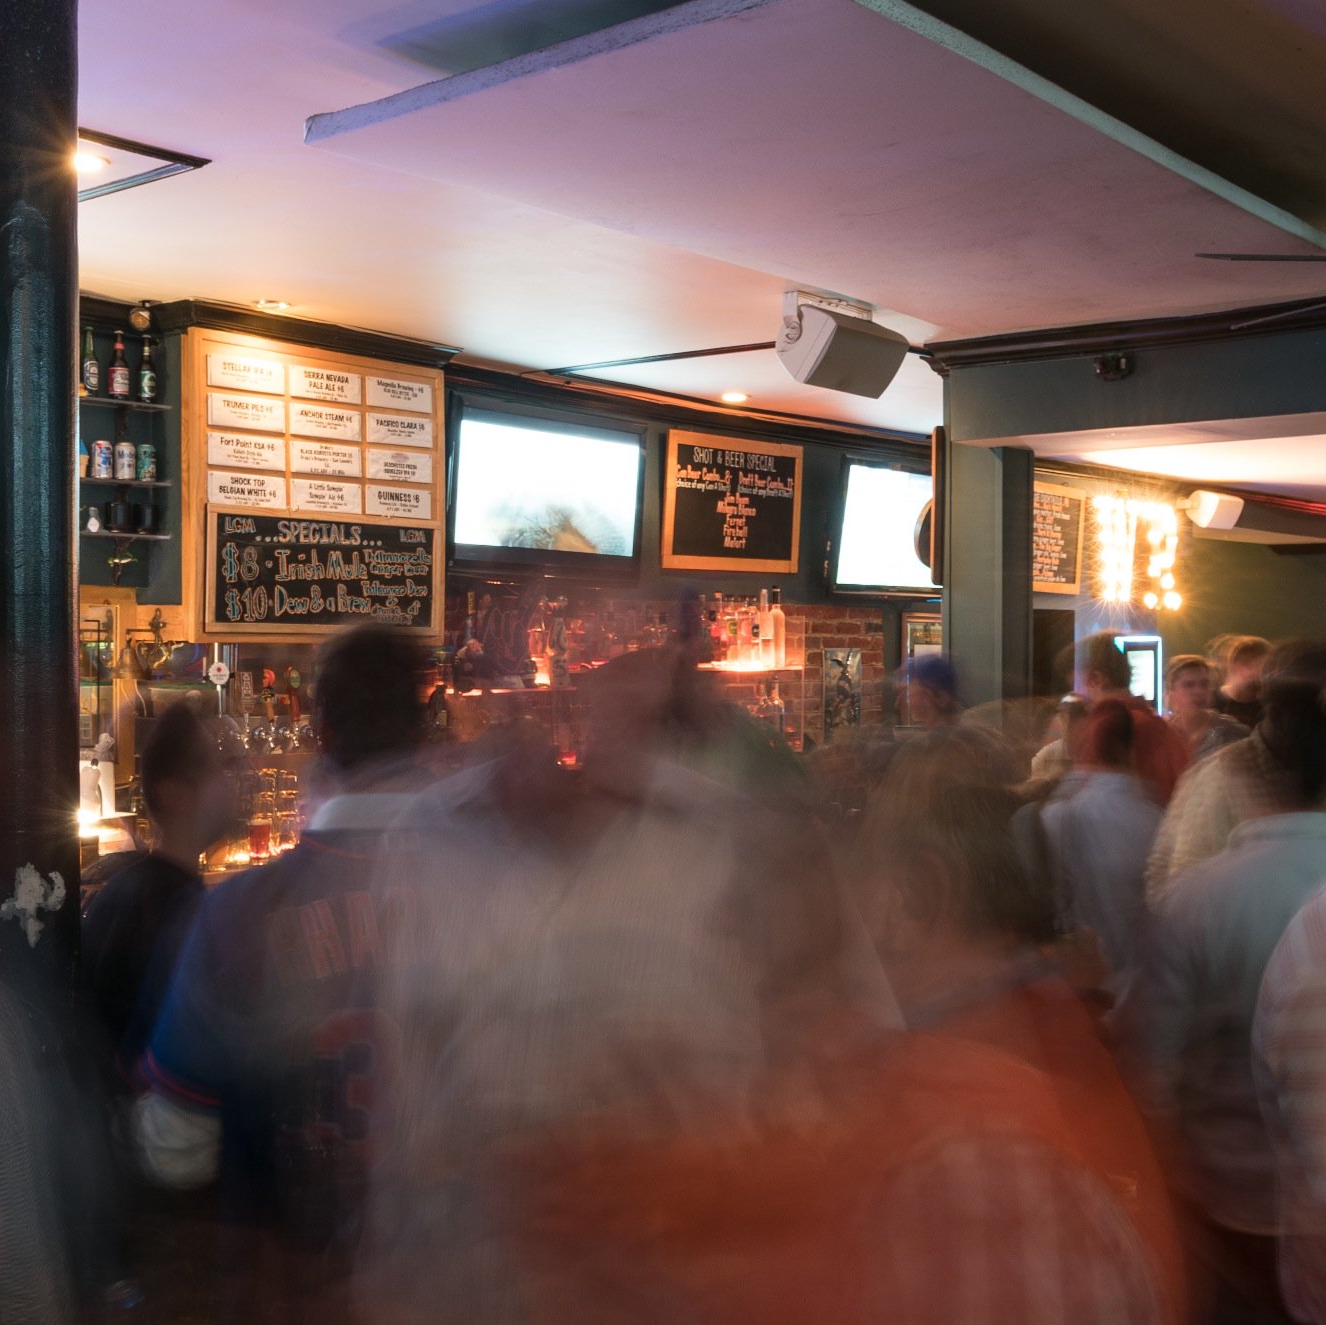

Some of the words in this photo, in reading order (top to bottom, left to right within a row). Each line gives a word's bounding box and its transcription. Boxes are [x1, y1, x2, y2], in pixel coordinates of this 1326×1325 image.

[325, 374, 349, 384] NEVADA
[325, 412, 344, 422] STEAM
[220, 437, 234, 446] Fort
[236, 439, 252, 449] Point
[693, 447, 714, 465] SHOT
[725, 451, 745, 468] BEER
[746, 453, 777, 473] SPECIAL
[231, 477, 251, 486] SHOCK
[254, 479, 266, 487] TOP
[219, 485, 248, 495] BELGIAN
[247, 487, 267, 497] WHITE
[377, 490, 412, 503] GUINNESS
[275, 549, 325, 581] Irish
[326, 551, 369, 580] Mule
[275, 585, 310, 616] Dew
